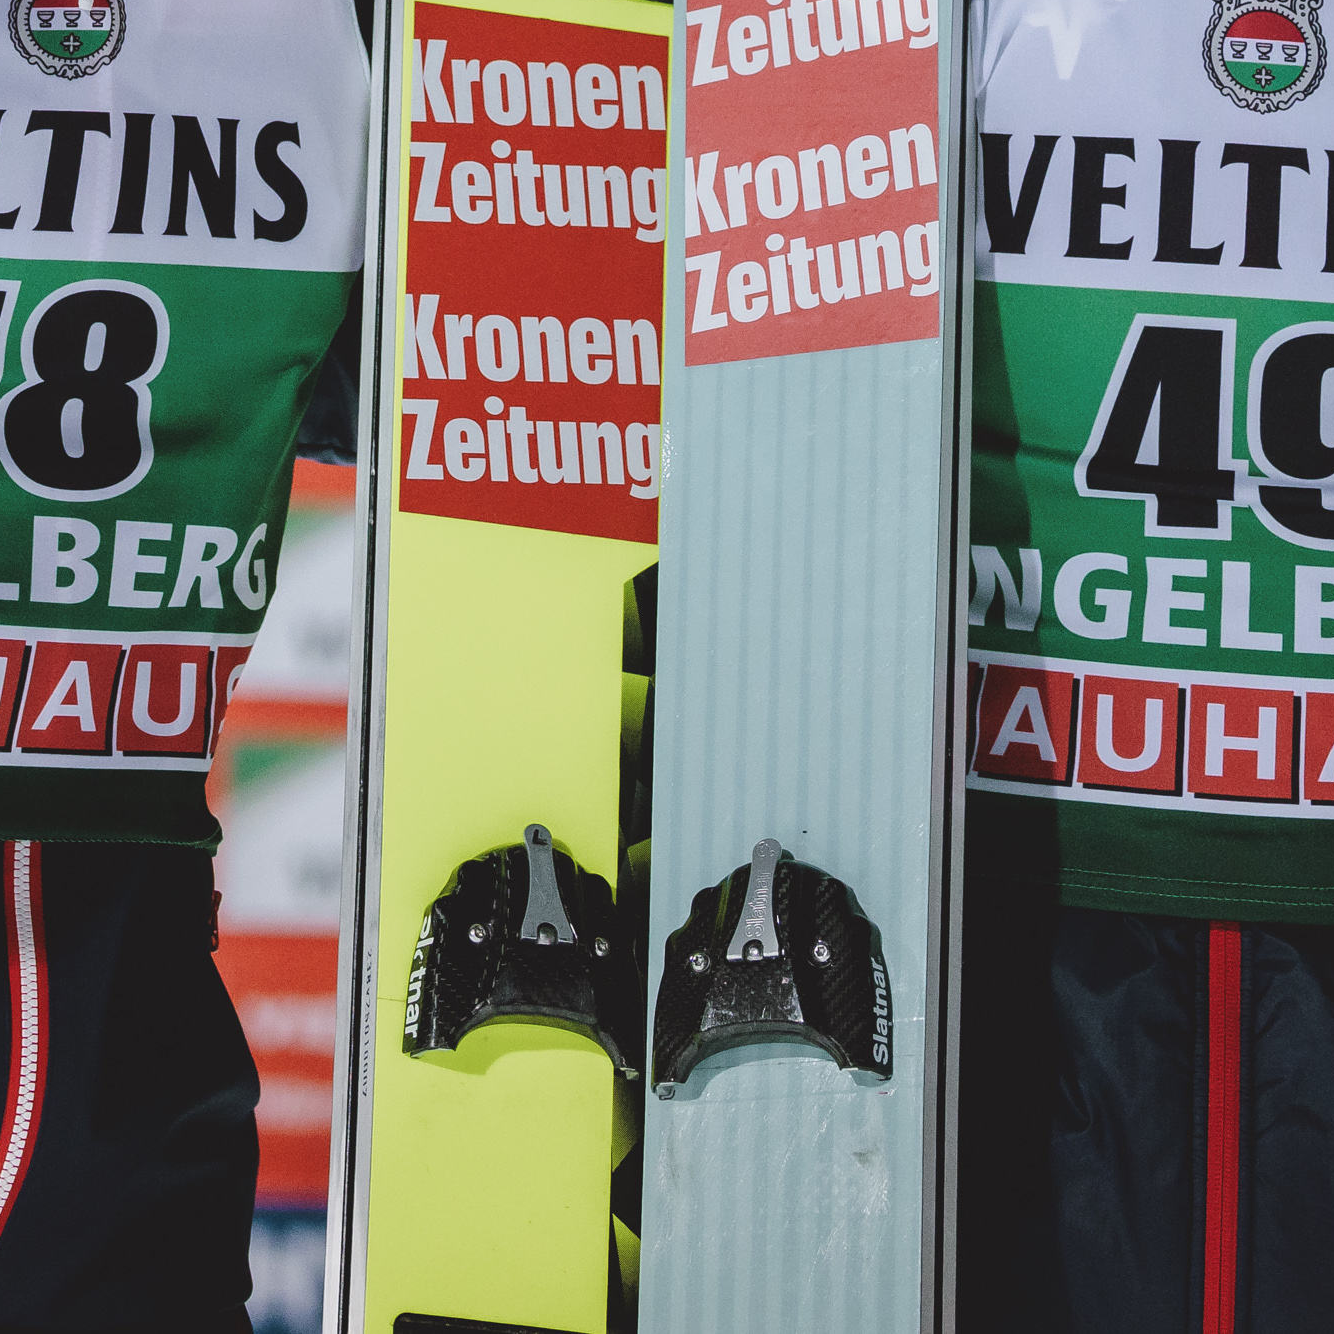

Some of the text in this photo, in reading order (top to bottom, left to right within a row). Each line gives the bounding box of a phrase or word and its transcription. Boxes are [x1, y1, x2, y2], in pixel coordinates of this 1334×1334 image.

[410, 38, 666, 132] Kronen
[409, 140, 667, 243] Zeitung
[685, 121, 934, 238] Kronen
[685, 219, 940, 335] Zeitung
[402, 293, 660, 387] Kronen
[401, 397, 661, 500] Zeitung
[869, 956, 889, 1066] Slatnar
